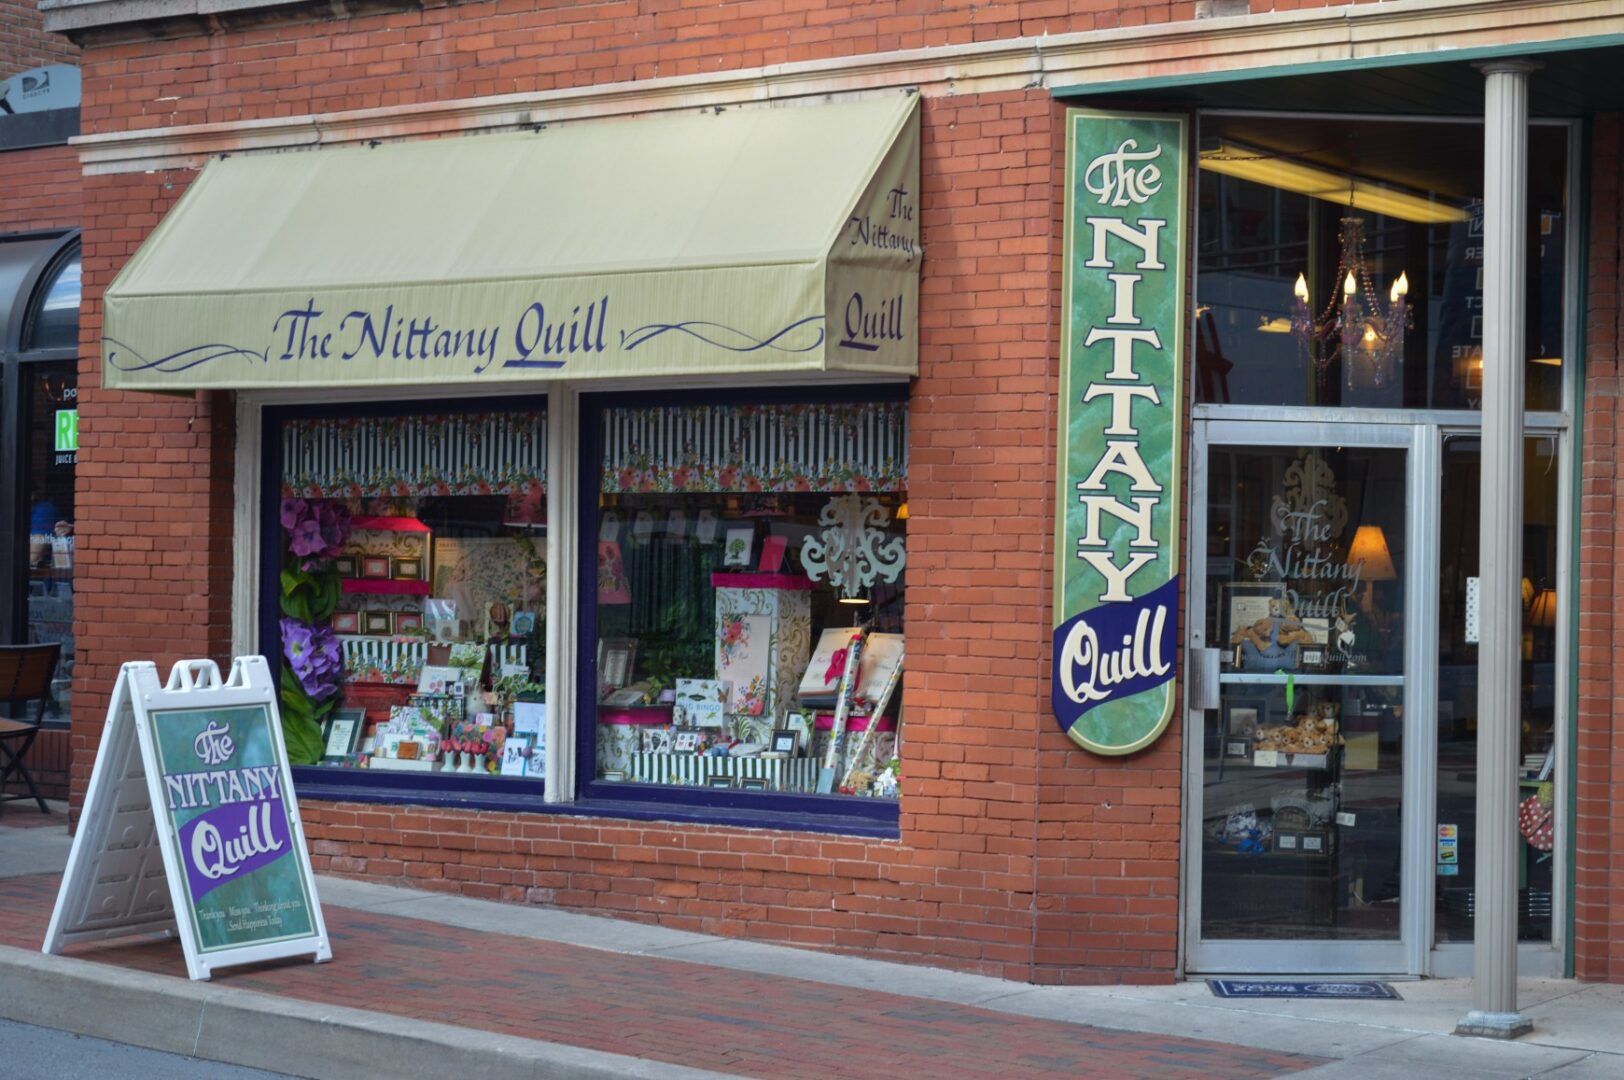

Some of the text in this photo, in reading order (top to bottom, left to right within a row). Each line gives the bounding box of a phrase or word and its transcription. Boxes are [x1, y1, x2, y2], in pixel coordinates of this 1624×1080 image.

[887, 183, 913, 221] The
[1084, 138, 1163, 207] The
[849, 215, 915, 262] Nittany
[272, 295, 610, 374] The Nittany Quill
[839, 291, 904, 351] Quill
[1076, 215, 1168, 602] NITTANY
[55, 454, 72, 466] JUICE
[1278, 499, 1332, 542] The
[1247, 539, 1365, 598] Nittany
[1059, 604, 1171, 704] Quill
[195, 720, 235, 765] The
[164, 765, 280, 810] NITTANY
[191, 802, 284, 880] Quill
